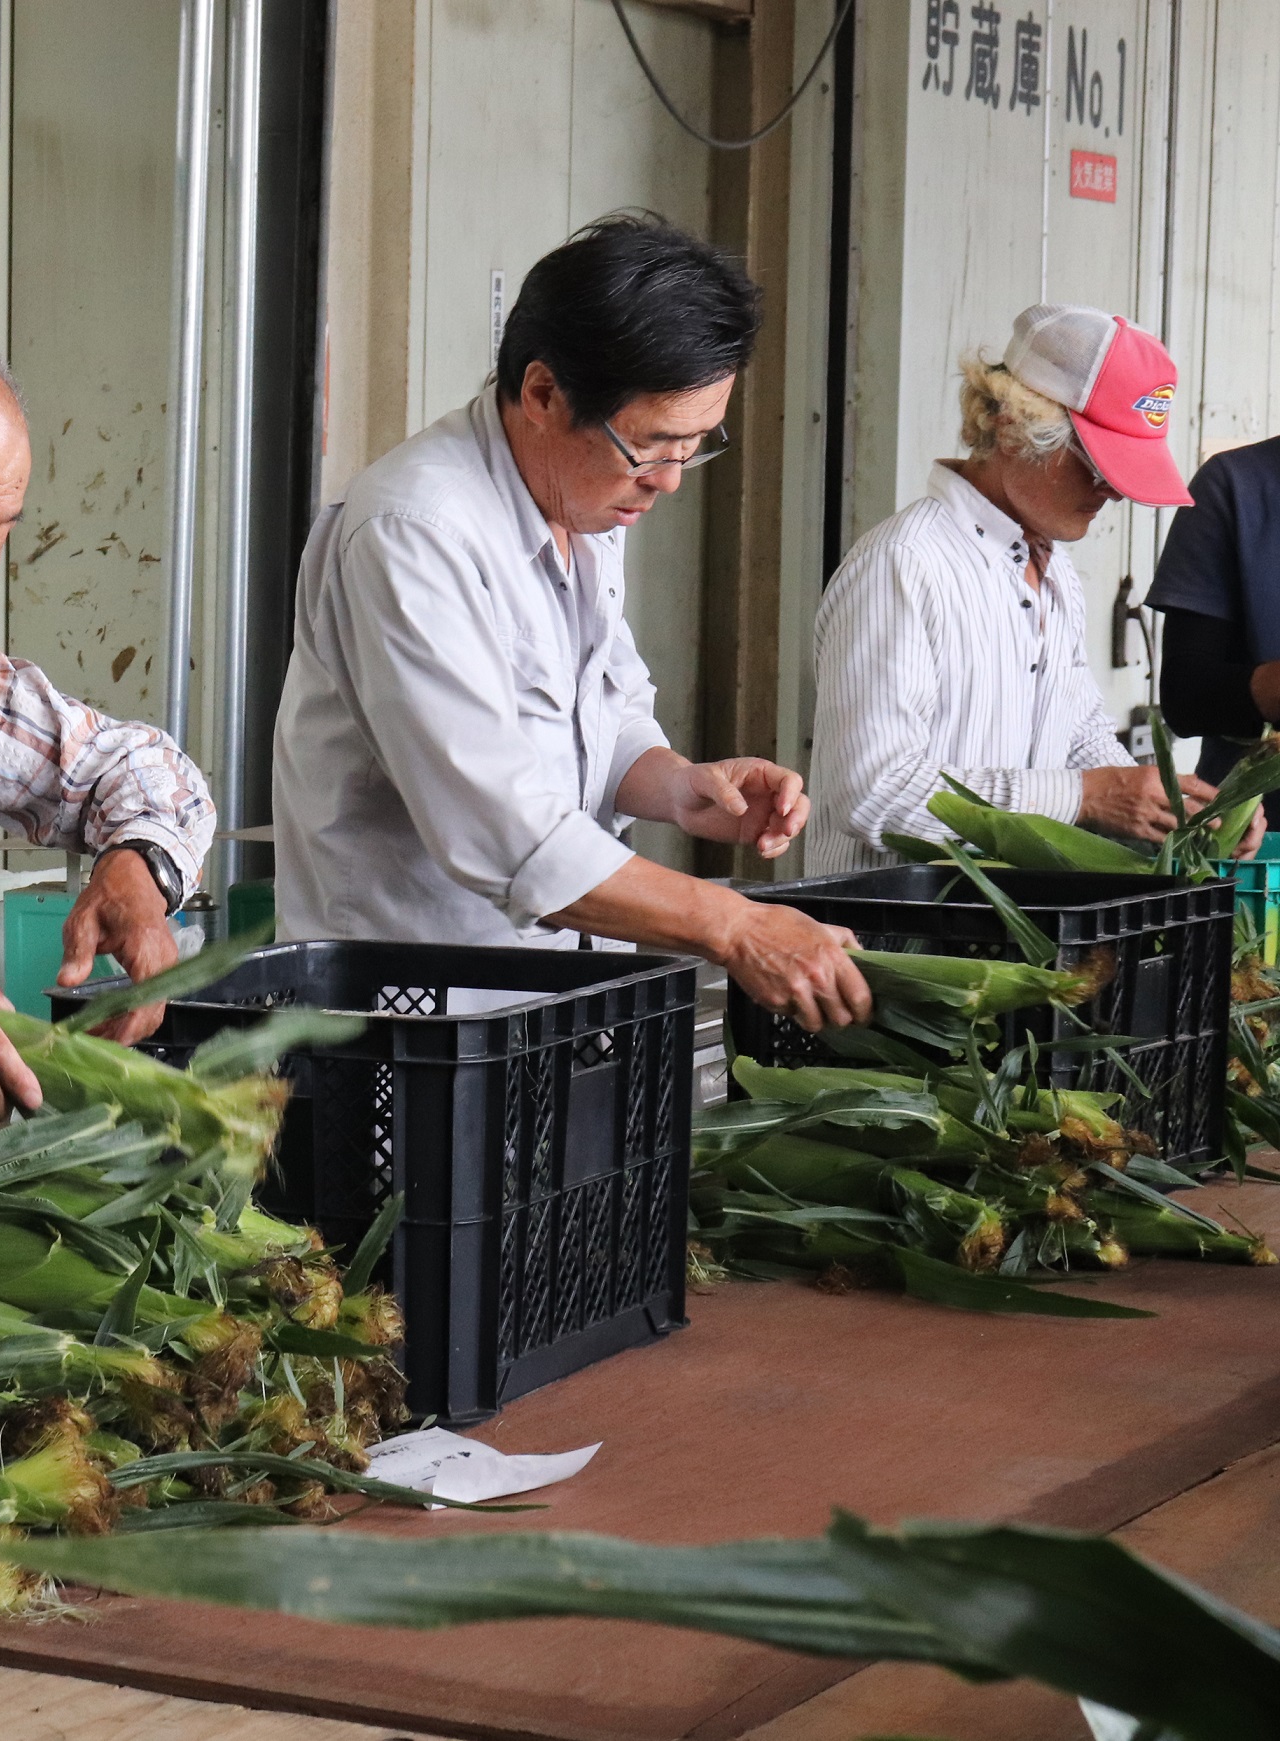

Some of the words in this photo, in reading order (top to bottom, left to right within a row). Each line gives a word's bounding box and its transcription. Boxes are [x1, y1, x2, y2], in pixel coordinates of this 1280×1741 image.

[923, 0, 1041, 116] 貯蔵庫
[1066, 25, 1125, 138] No.1
